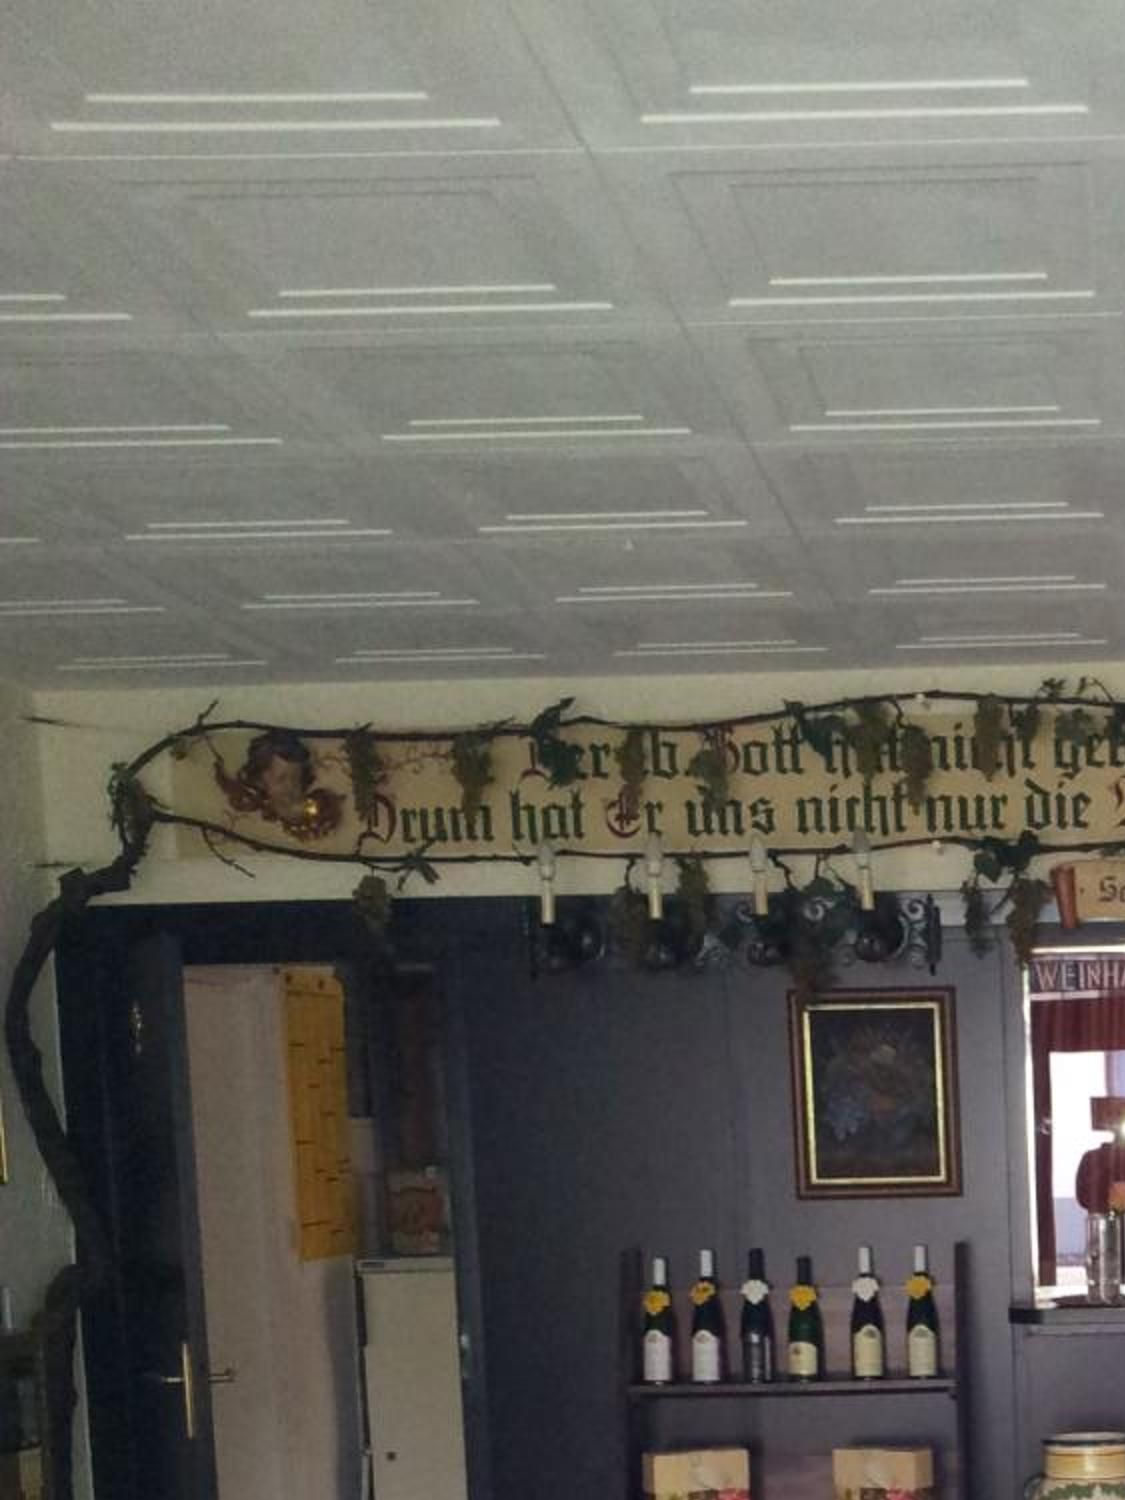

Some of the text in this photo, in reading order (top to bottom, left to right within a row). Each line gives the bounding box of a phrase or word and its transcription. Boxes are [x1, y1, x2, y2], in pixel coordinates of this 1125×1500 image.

[355, 795, 494, 856] Drum
[510, 788, 584, 844] hat
[797, 780, 908, 837] nicht
[926, 793, 1008, 833] nur
[1024, 777, 1092, 830] die
